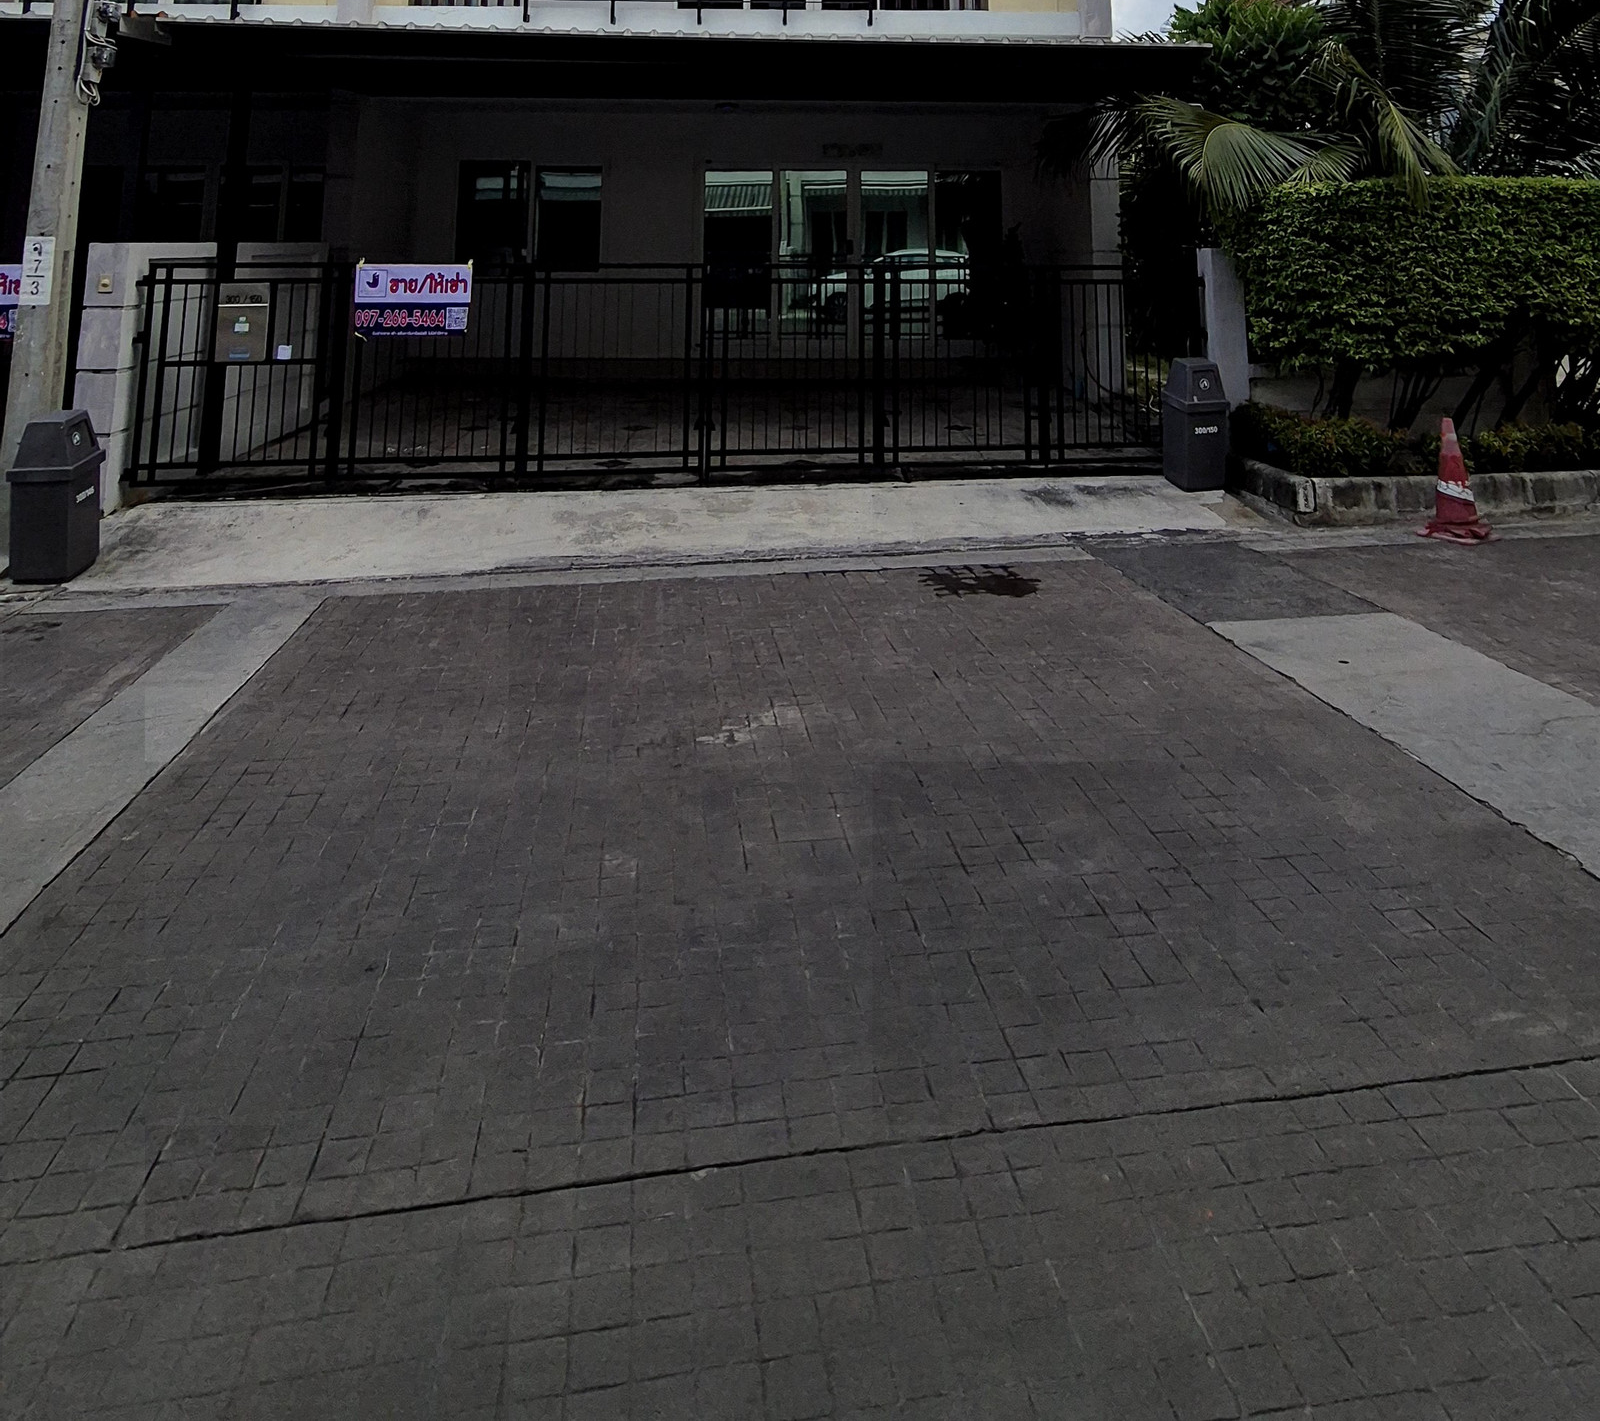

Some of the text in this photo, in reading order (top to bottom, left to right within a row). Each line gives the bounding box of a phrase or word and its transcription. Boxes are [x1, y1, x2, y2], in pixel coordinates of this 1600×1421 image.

[33, 259, 43, 274] 7
[30, 280, 41, 296] 3
[389, 271, 468, 294] ขาย/ให้เช่า
[355, 309, 445, 328] 097-268-5464
[1194, 425, 1219, 435] 300/150
